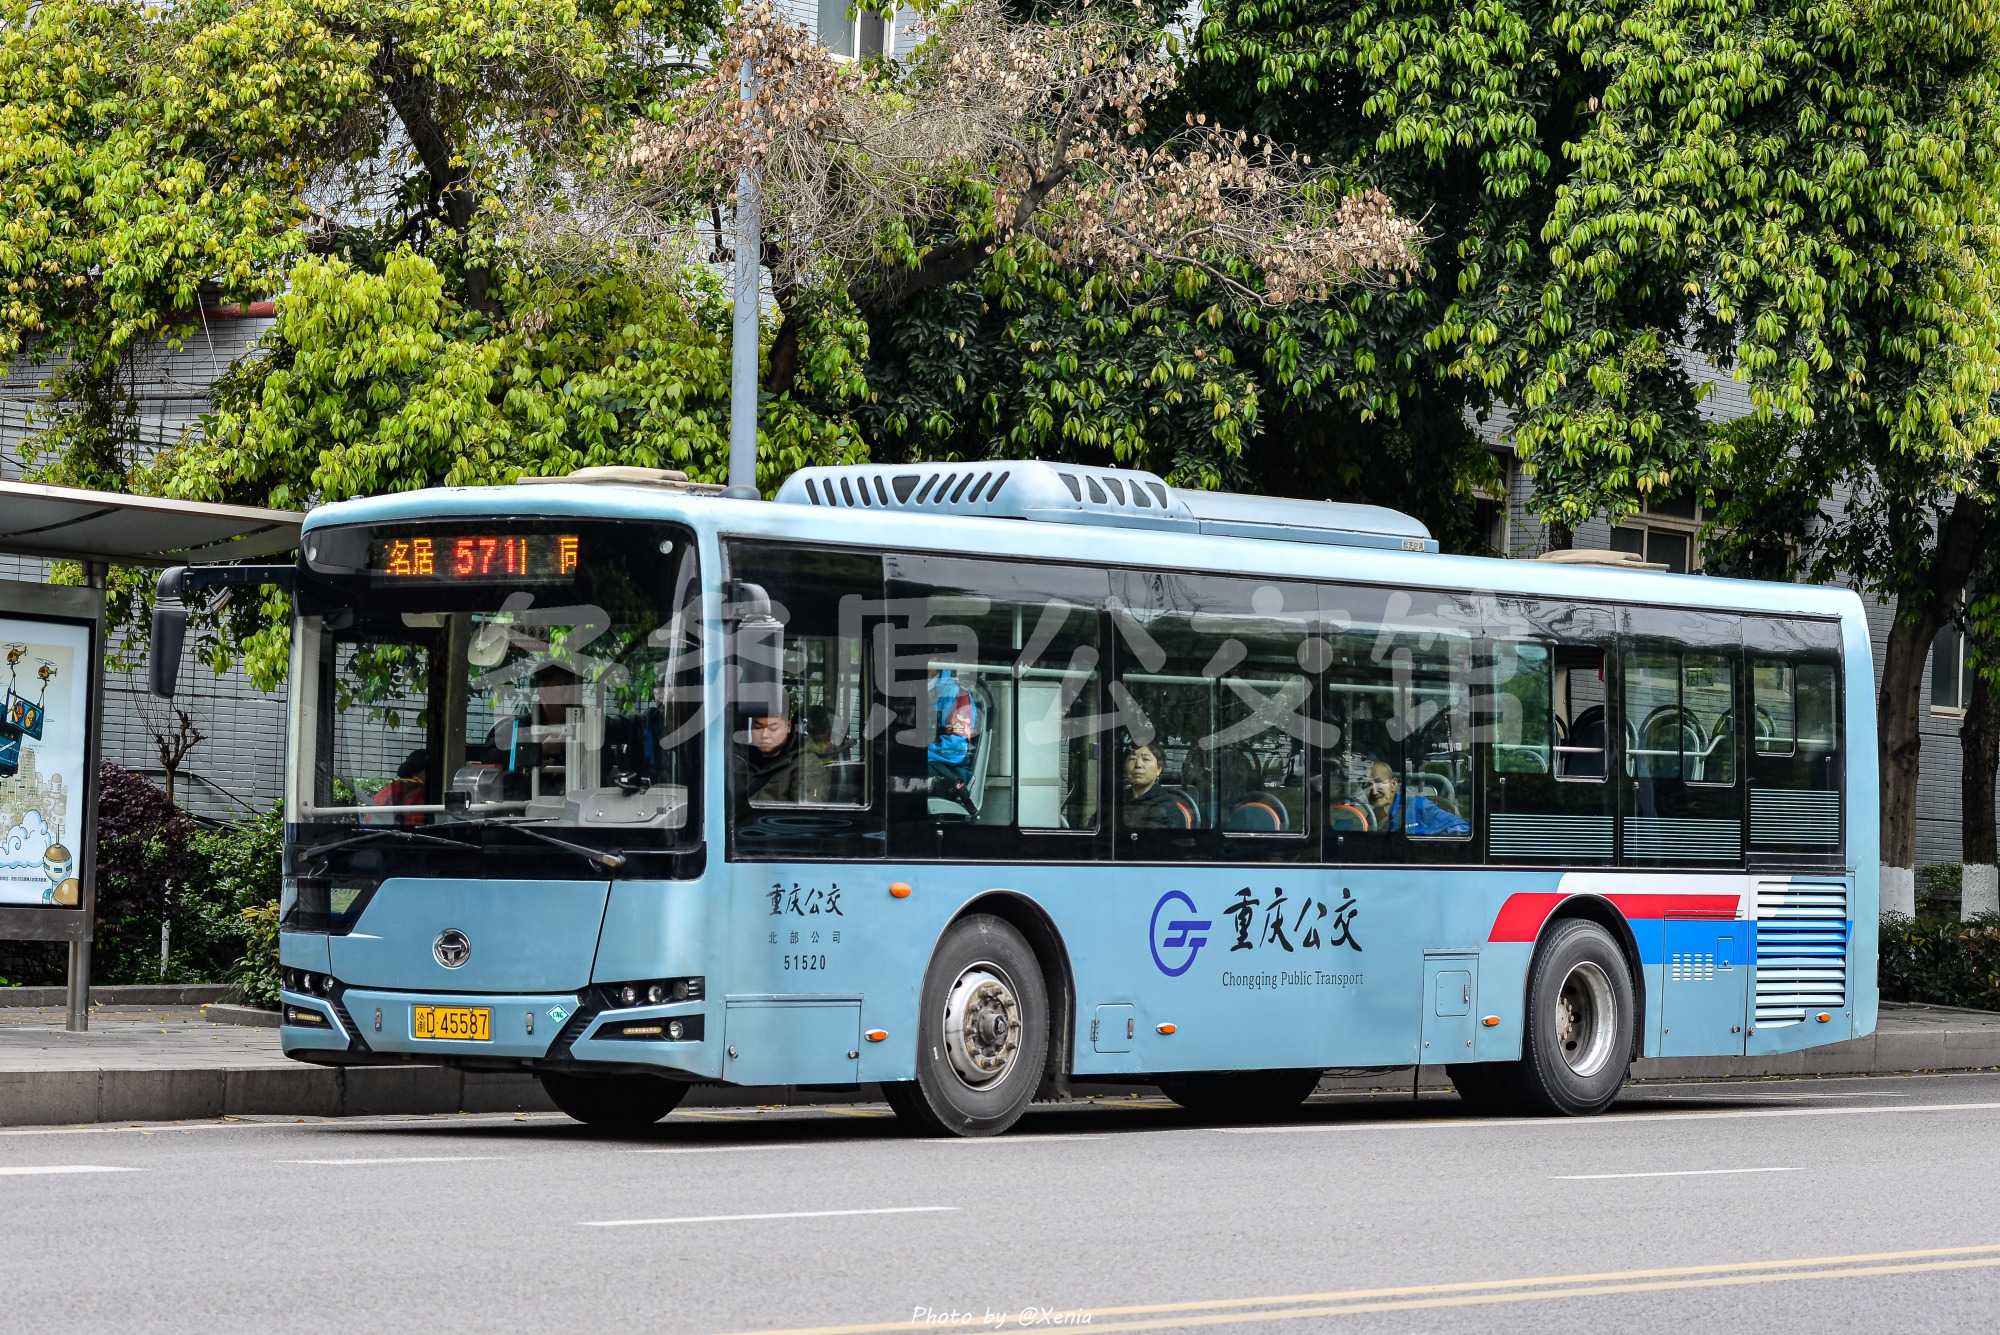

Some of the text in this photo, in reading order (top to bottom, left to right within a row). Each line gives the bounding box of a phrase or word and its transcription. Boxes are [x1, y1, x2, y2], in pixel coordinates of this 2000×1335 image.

[766, 882, 844, 916] 重庆公交
[1223, 886, 1363, 952] 重庆公交
[768, 930, 841, 944] 北部公司
[784, 954, 826, 970] 51520
[1222, 970, 1364, 989] Chongqing Public Transport
